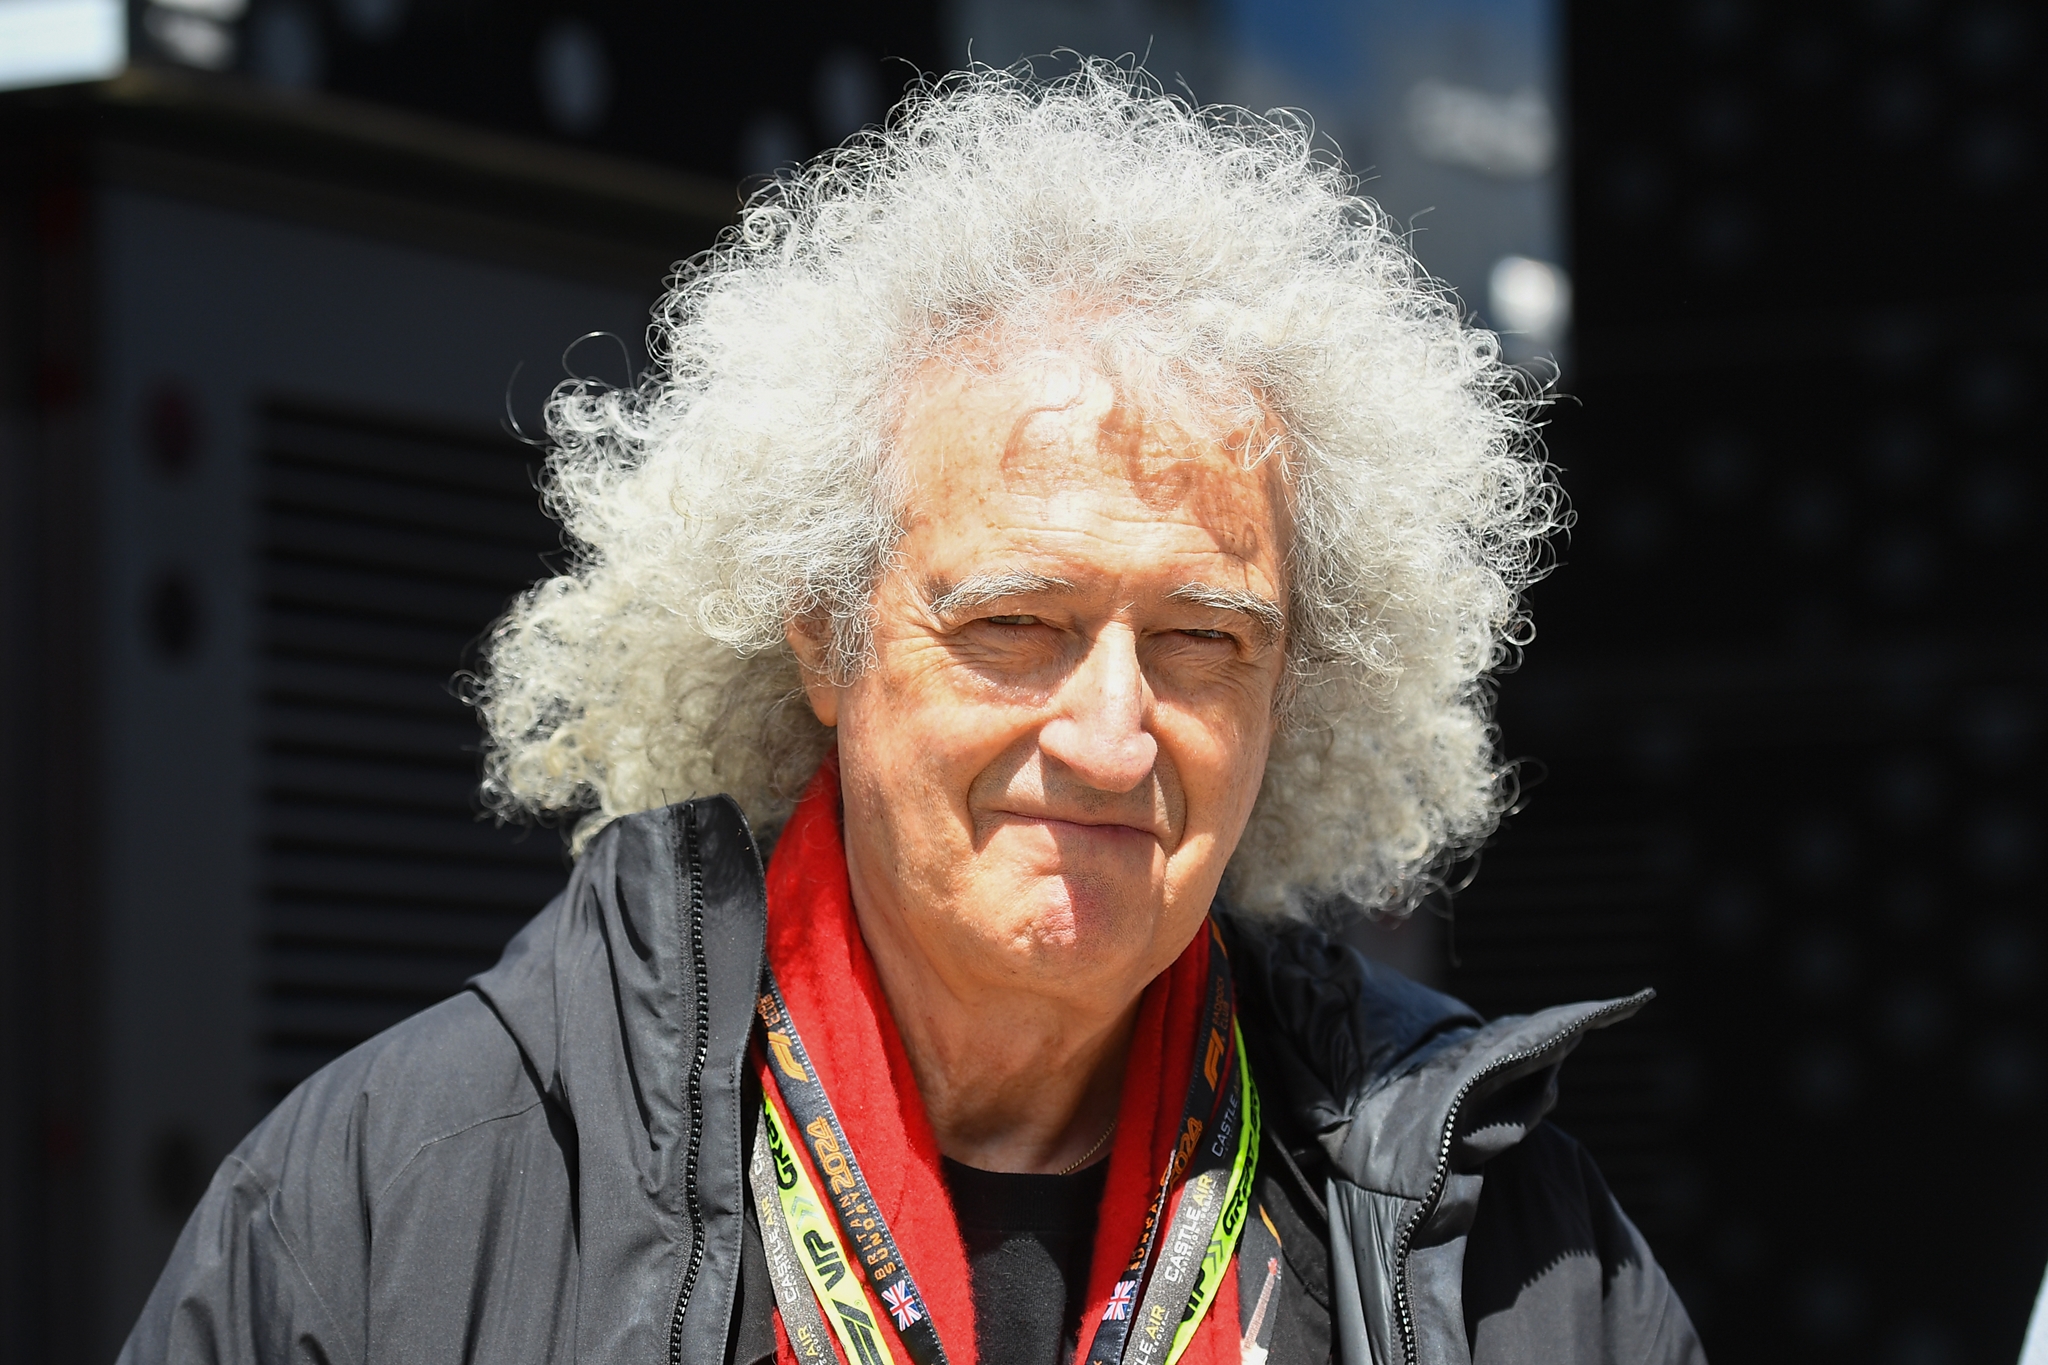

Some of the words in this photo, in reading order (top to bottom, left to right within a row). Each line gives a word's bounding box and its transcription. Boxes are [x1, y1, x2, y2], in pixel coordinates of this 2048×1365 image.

[762, 993, 781, 1026] CLUB
[764, 1103, 798, 1190] GRE
[806, 1115, 856, 1196] 2024
[1211, 1094, 1239, 1158] CASTLE
[761, 1195, 775, 1226] AIR
[839, 1195, 887, 1281] BRITAIN
[848, 1191, 897, 1276] SUNDAY
[1164, 1205, 1201, 1282] CASTLE
[1192, 1172, 1214, 1207] AIR
[768, 1228, 797, 1304] CASTLE
[803, 1229, 846, 1292] VIP
[797, 1325, 819, 1356] AIR
[1144, 1303, 1167, 1340] AIR
